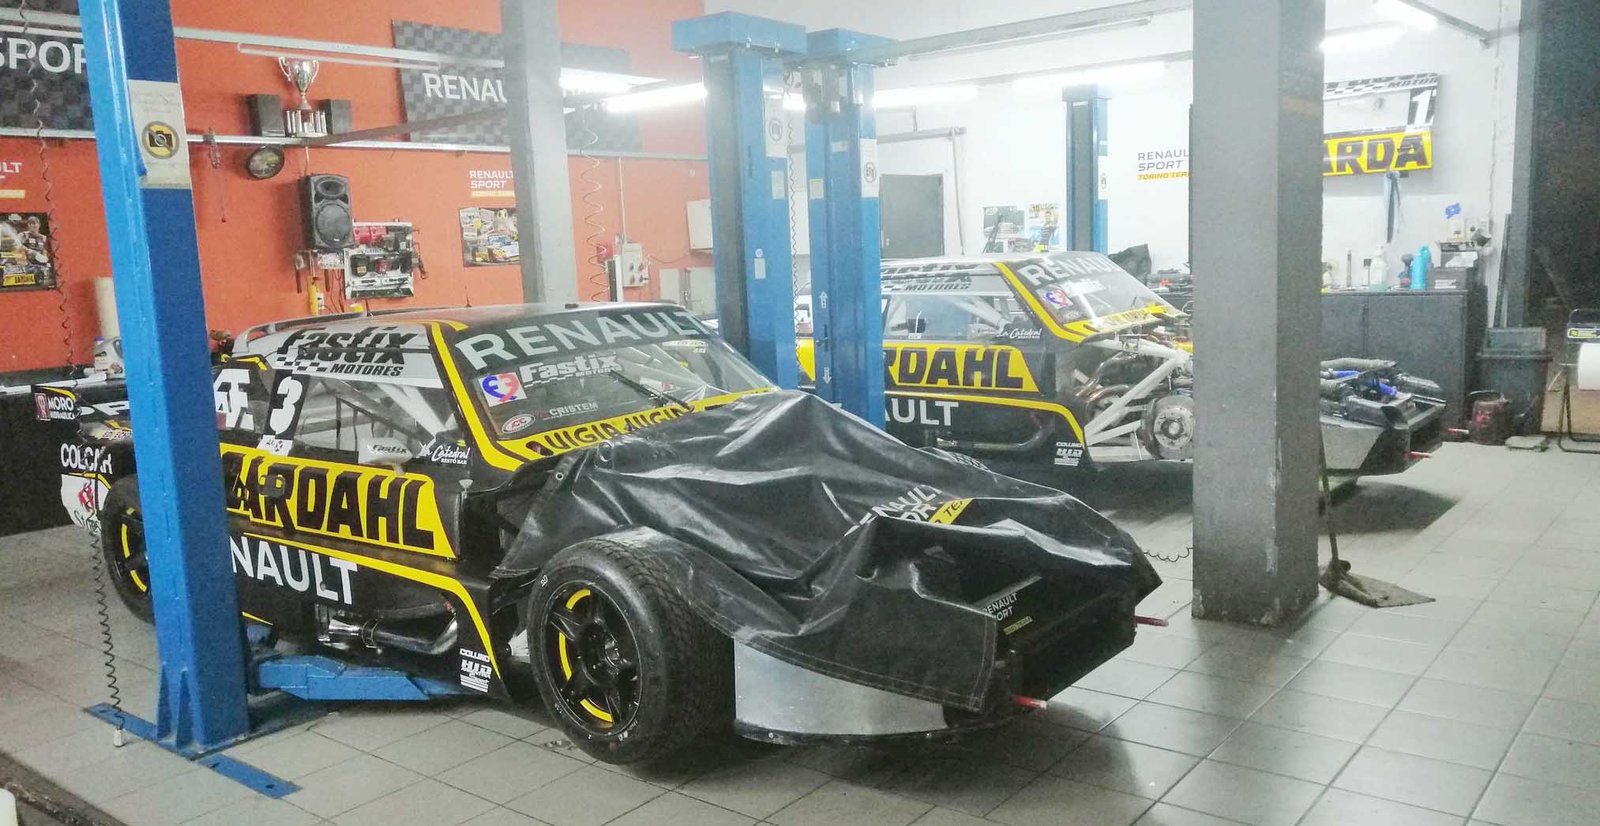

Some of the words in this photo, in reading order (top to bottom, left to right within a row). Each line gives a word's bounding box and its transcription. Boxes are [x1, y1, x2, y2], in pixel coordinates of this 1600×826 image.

[1138, 160, 1184, 171] SPORT
[471, 180, 507, 189] SPORT
[330, 363, 404, 377] MOTORES
[520, 351, 623, 383] Fastix
[47, 396, 74, 412] MORO
[269, 376, 303, 435] 3
[549, 402, 599, 416] CRISTEM
[431, 444, 471, 462] Catedral
